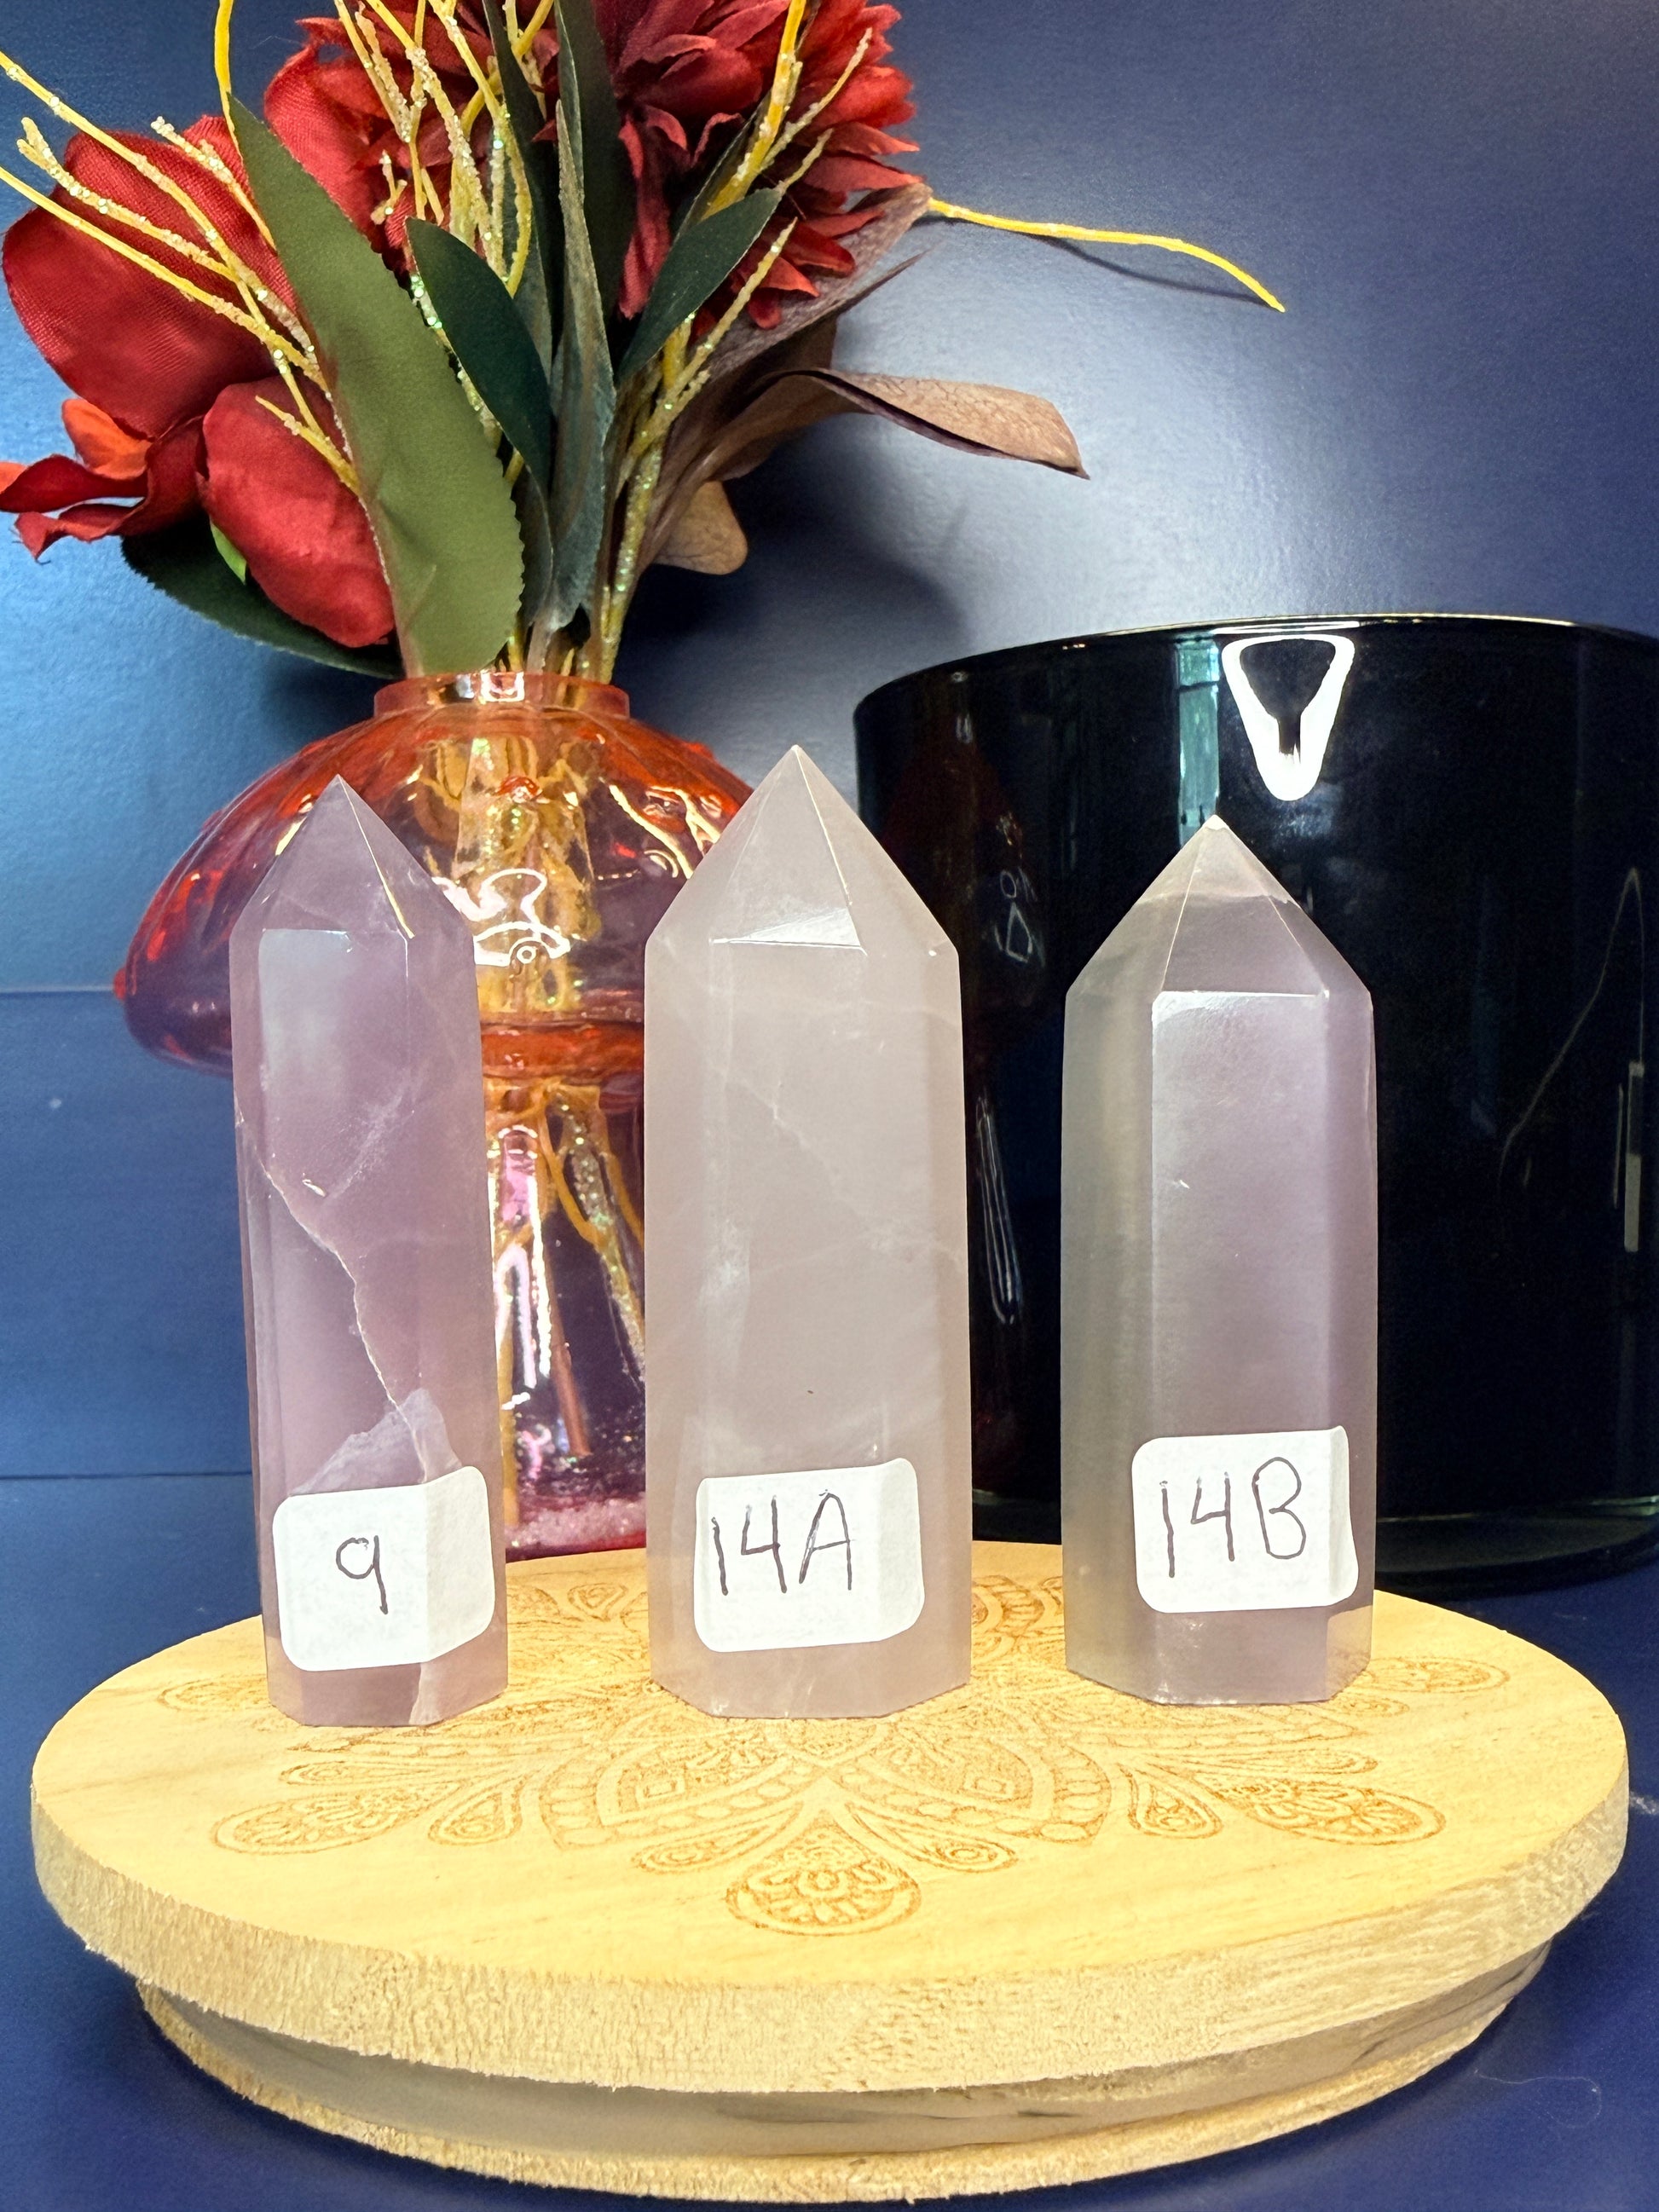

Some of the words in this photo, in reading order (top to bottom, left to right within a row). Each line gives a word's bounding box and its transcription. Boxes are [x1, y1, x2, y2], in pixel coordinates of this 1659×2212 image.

[711, 1492, 853, 1597] 14A
[1159, 1456, 1307, 1580] 14B
[335, 1535, 388, 1615] 9
